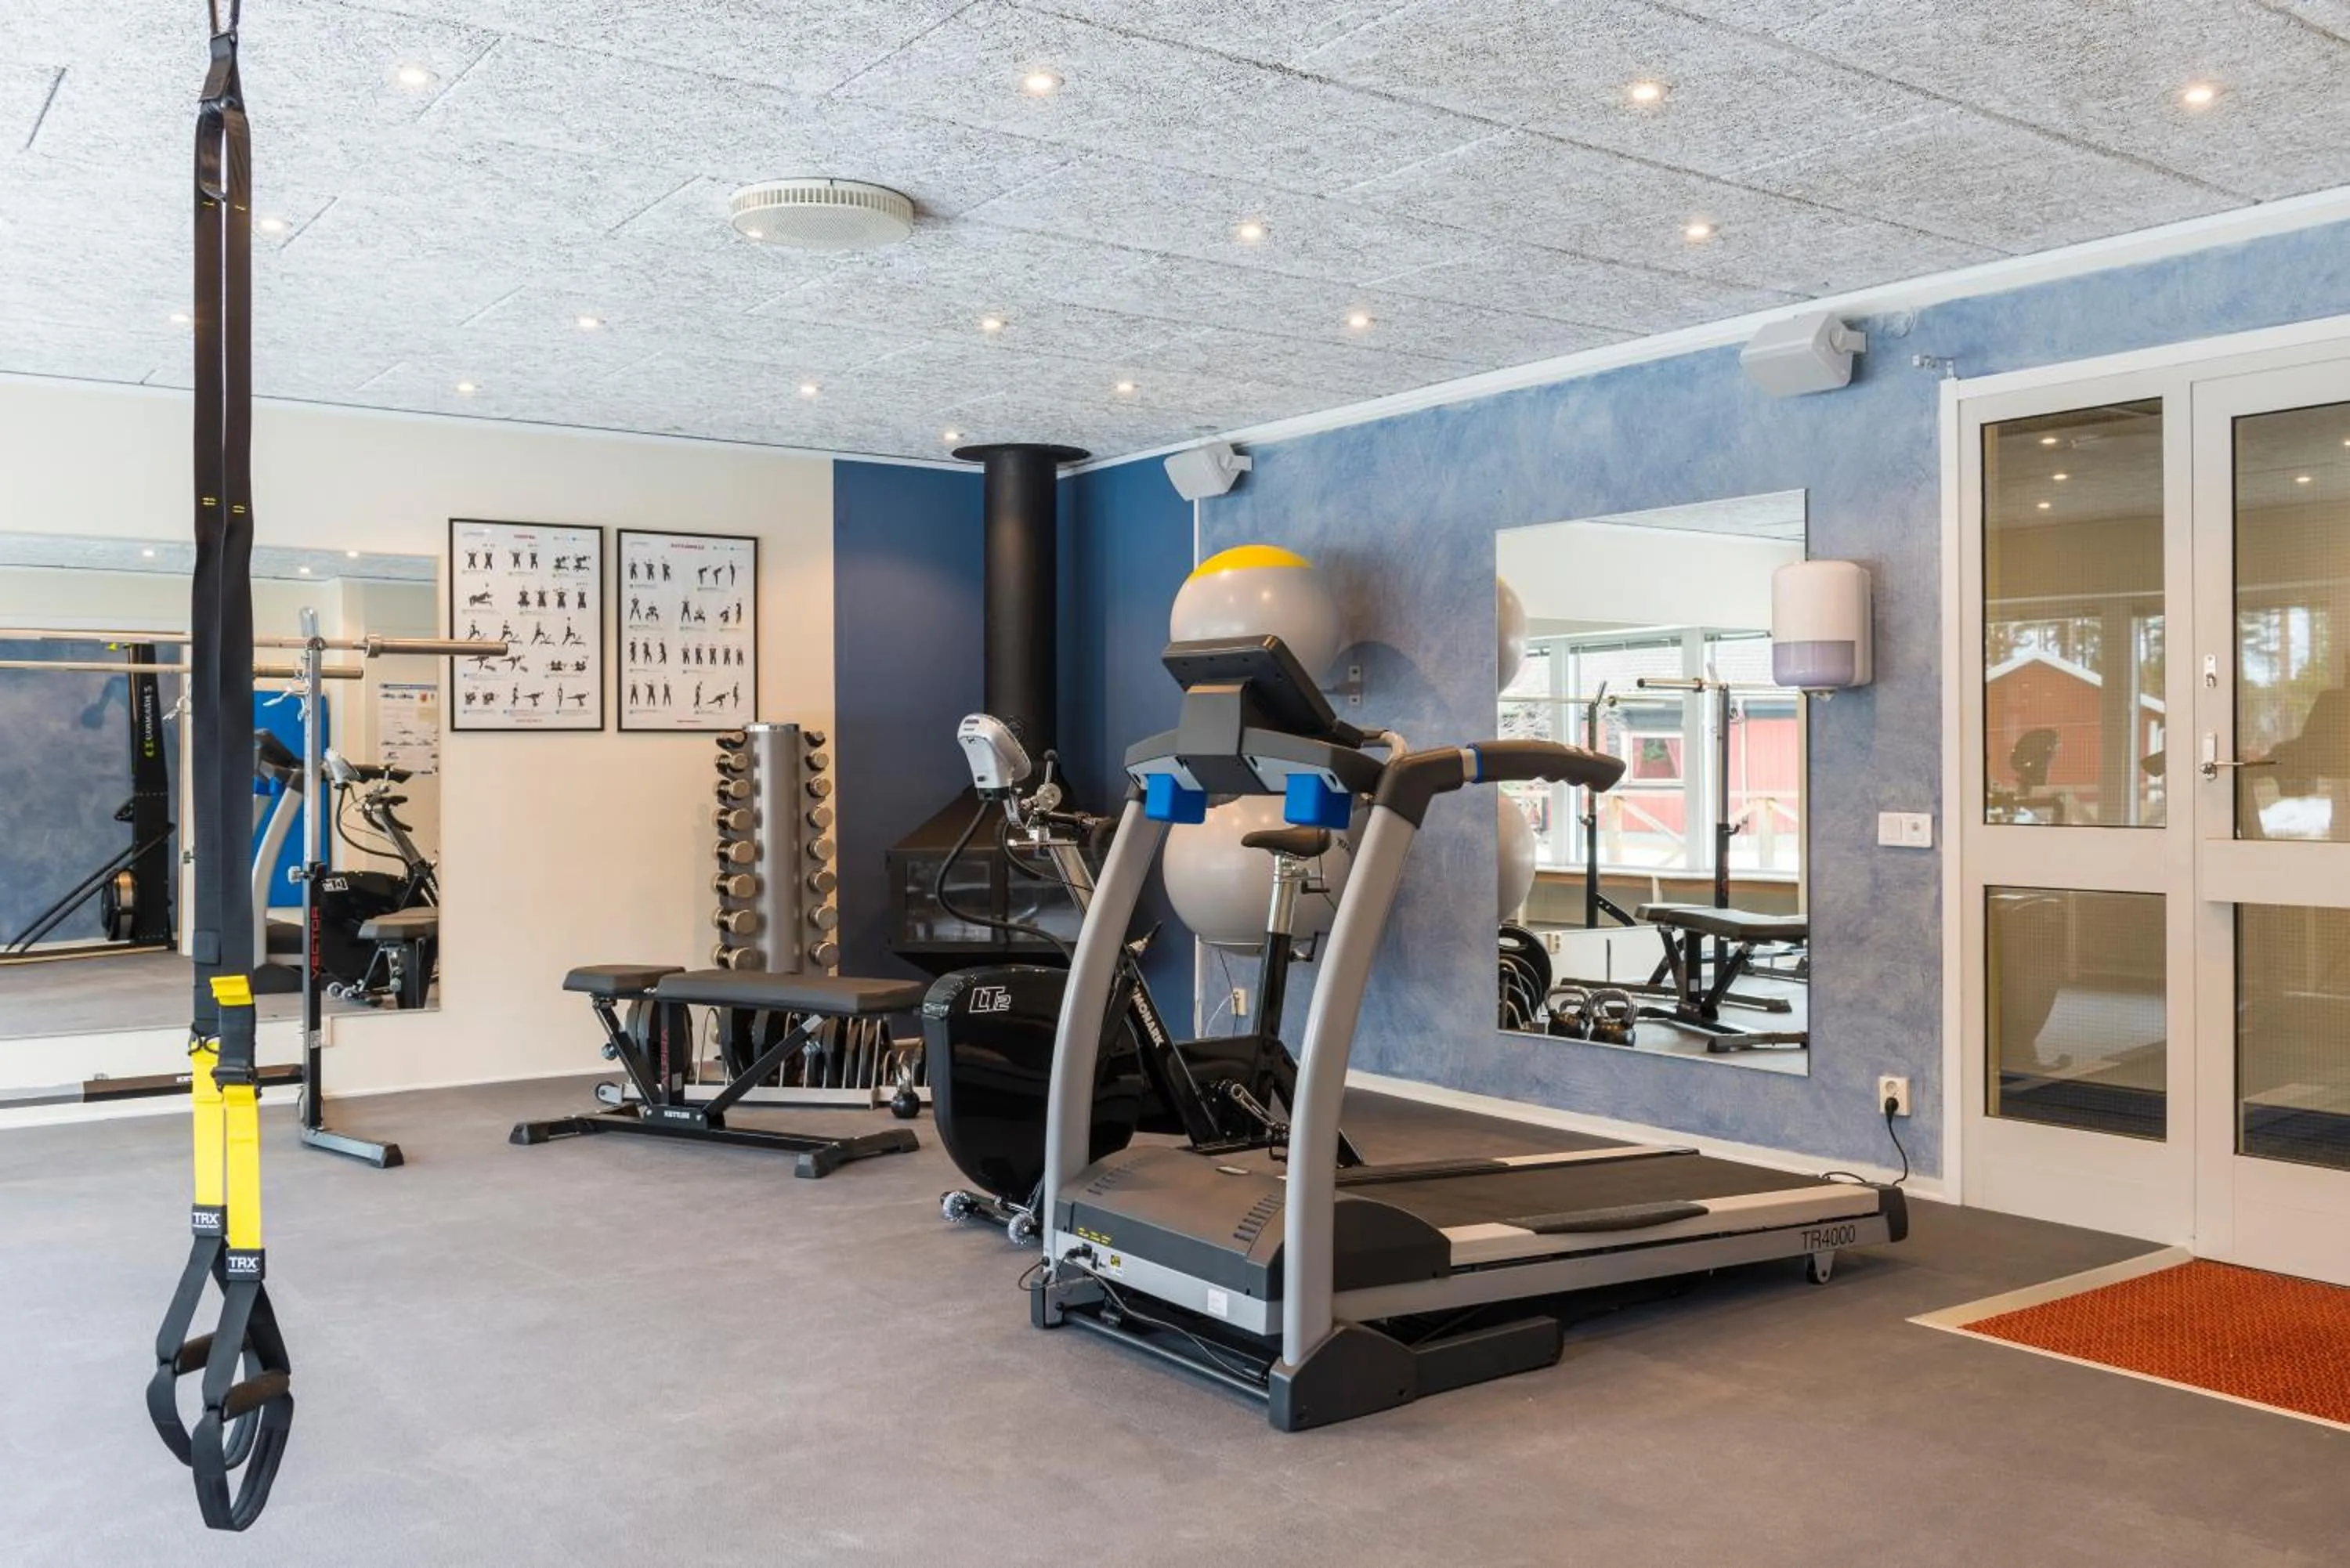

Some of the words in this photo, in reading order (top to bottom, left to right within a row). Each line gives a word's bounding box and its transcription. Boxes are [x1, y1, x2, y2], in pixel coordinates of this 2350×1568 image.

[311, 905, 320, 979] VECTOR
[969, 985, 1011, 1013] LT2
[1132, 993, 1165, 1048] MONARK
[193, 1212, 219, 1224] TRX
[1801, 1224, 1856, 1250] TR4000
[228, 1256, 259, 1269] TRX
